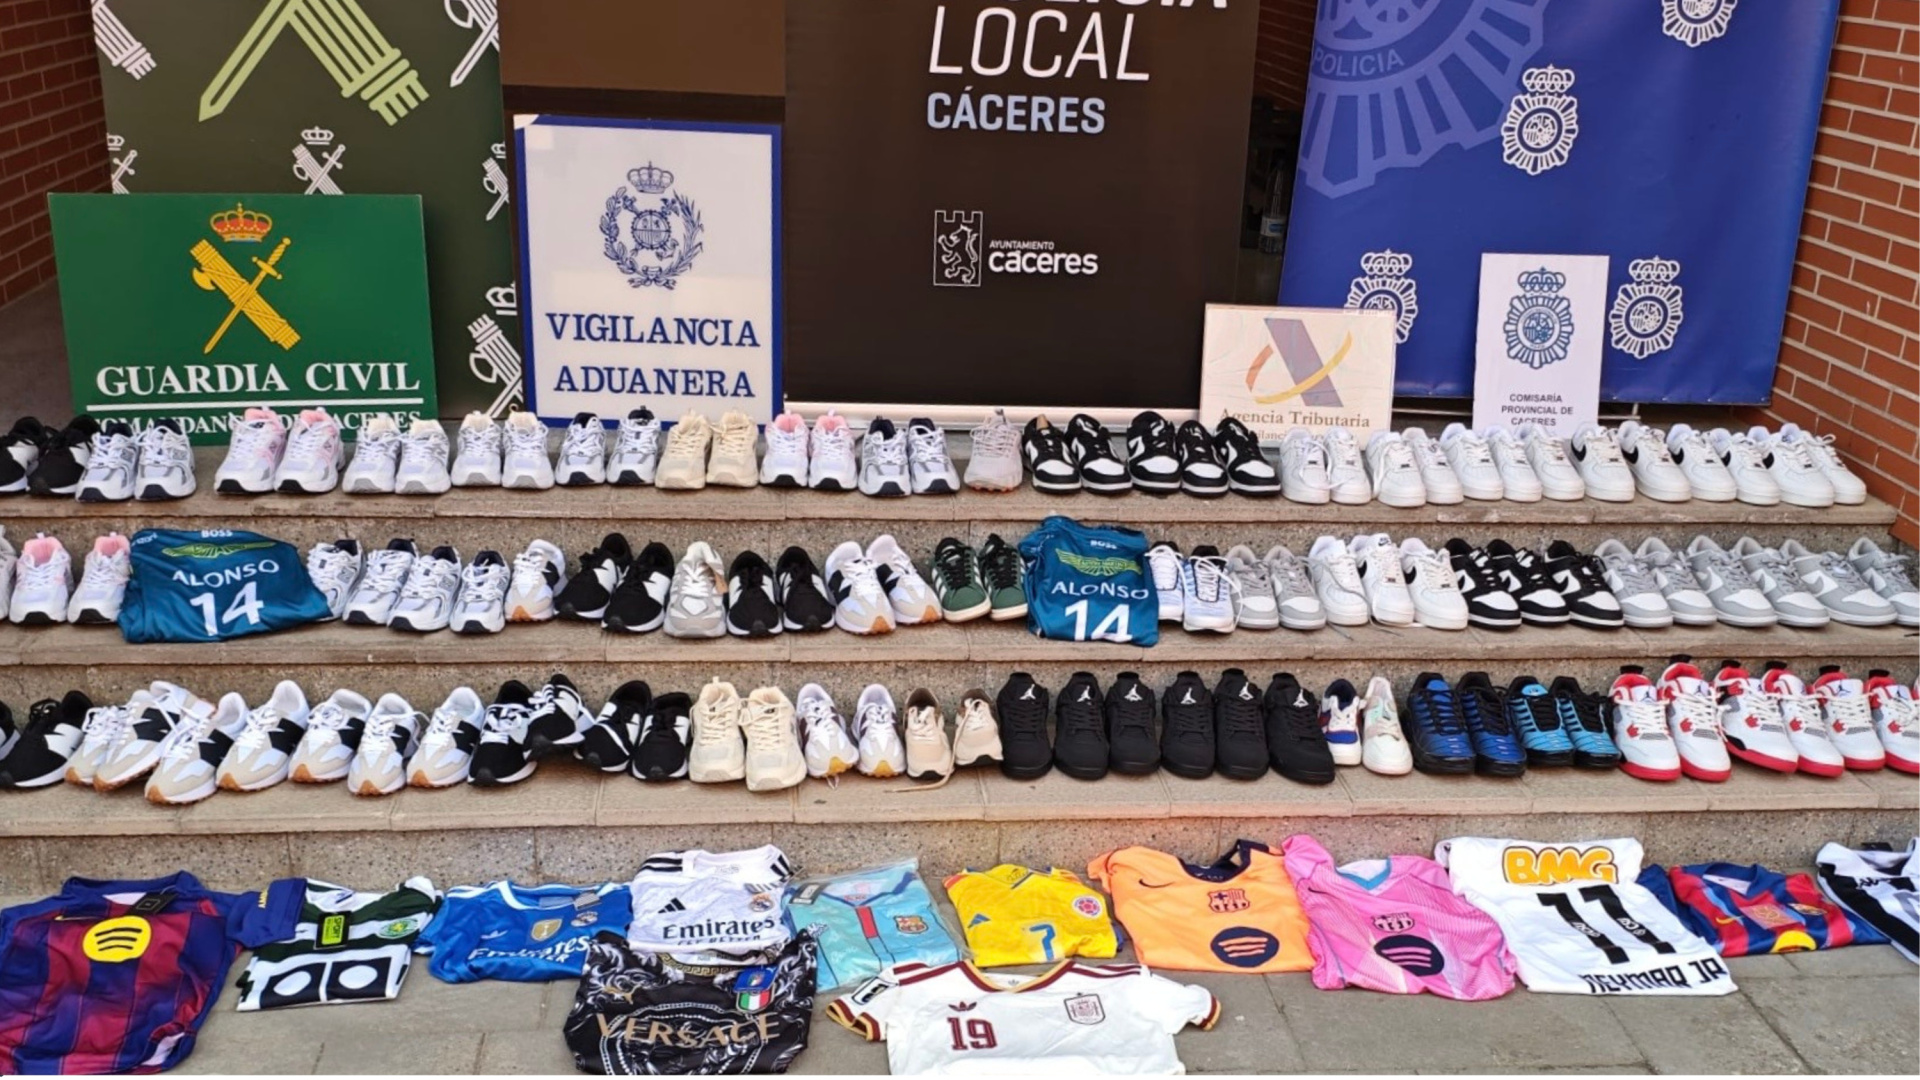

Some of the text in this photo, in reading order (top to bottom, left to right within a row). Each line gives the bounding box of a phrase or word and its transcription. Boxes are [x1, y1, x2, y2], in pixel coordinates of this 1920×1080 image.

[929, 6, 1149, 81] LOCAL
[1314, 47, 1405, 77] POLICIA
[927, 86, 1105, 134] CÁCERES
[989, 240, 1055, 250] AYUNTAMIENTO
[545, 313, 760, 347] VIGILANCIA
[96, 362, 420, 396] GUARDIA CIVIL
[553, 366, 755, 397] ADUANERA
[1289, 411, 1370, 428] Tributaria
[1501, 405, 1574, 415] PROVINCIAL DE
[201, 530, 233, 538] BOSS
[172, 559, 280, 588] ALONSO
[1051, 581, 1150, 600] ALONSO
[190, 581, 265, 637] 14
[1065, 599, 1133, 642] 14
[1502, 846, 1619, 886] BMG
[663, 916, 776, 940] Emirates
[1536, 884, 1677, 965] 11
[1578, 965, 1692, 994] NEYMAR
[597, 1012, 780, 1049] VERSACE
[946, 1017, 998, 1051] 19
